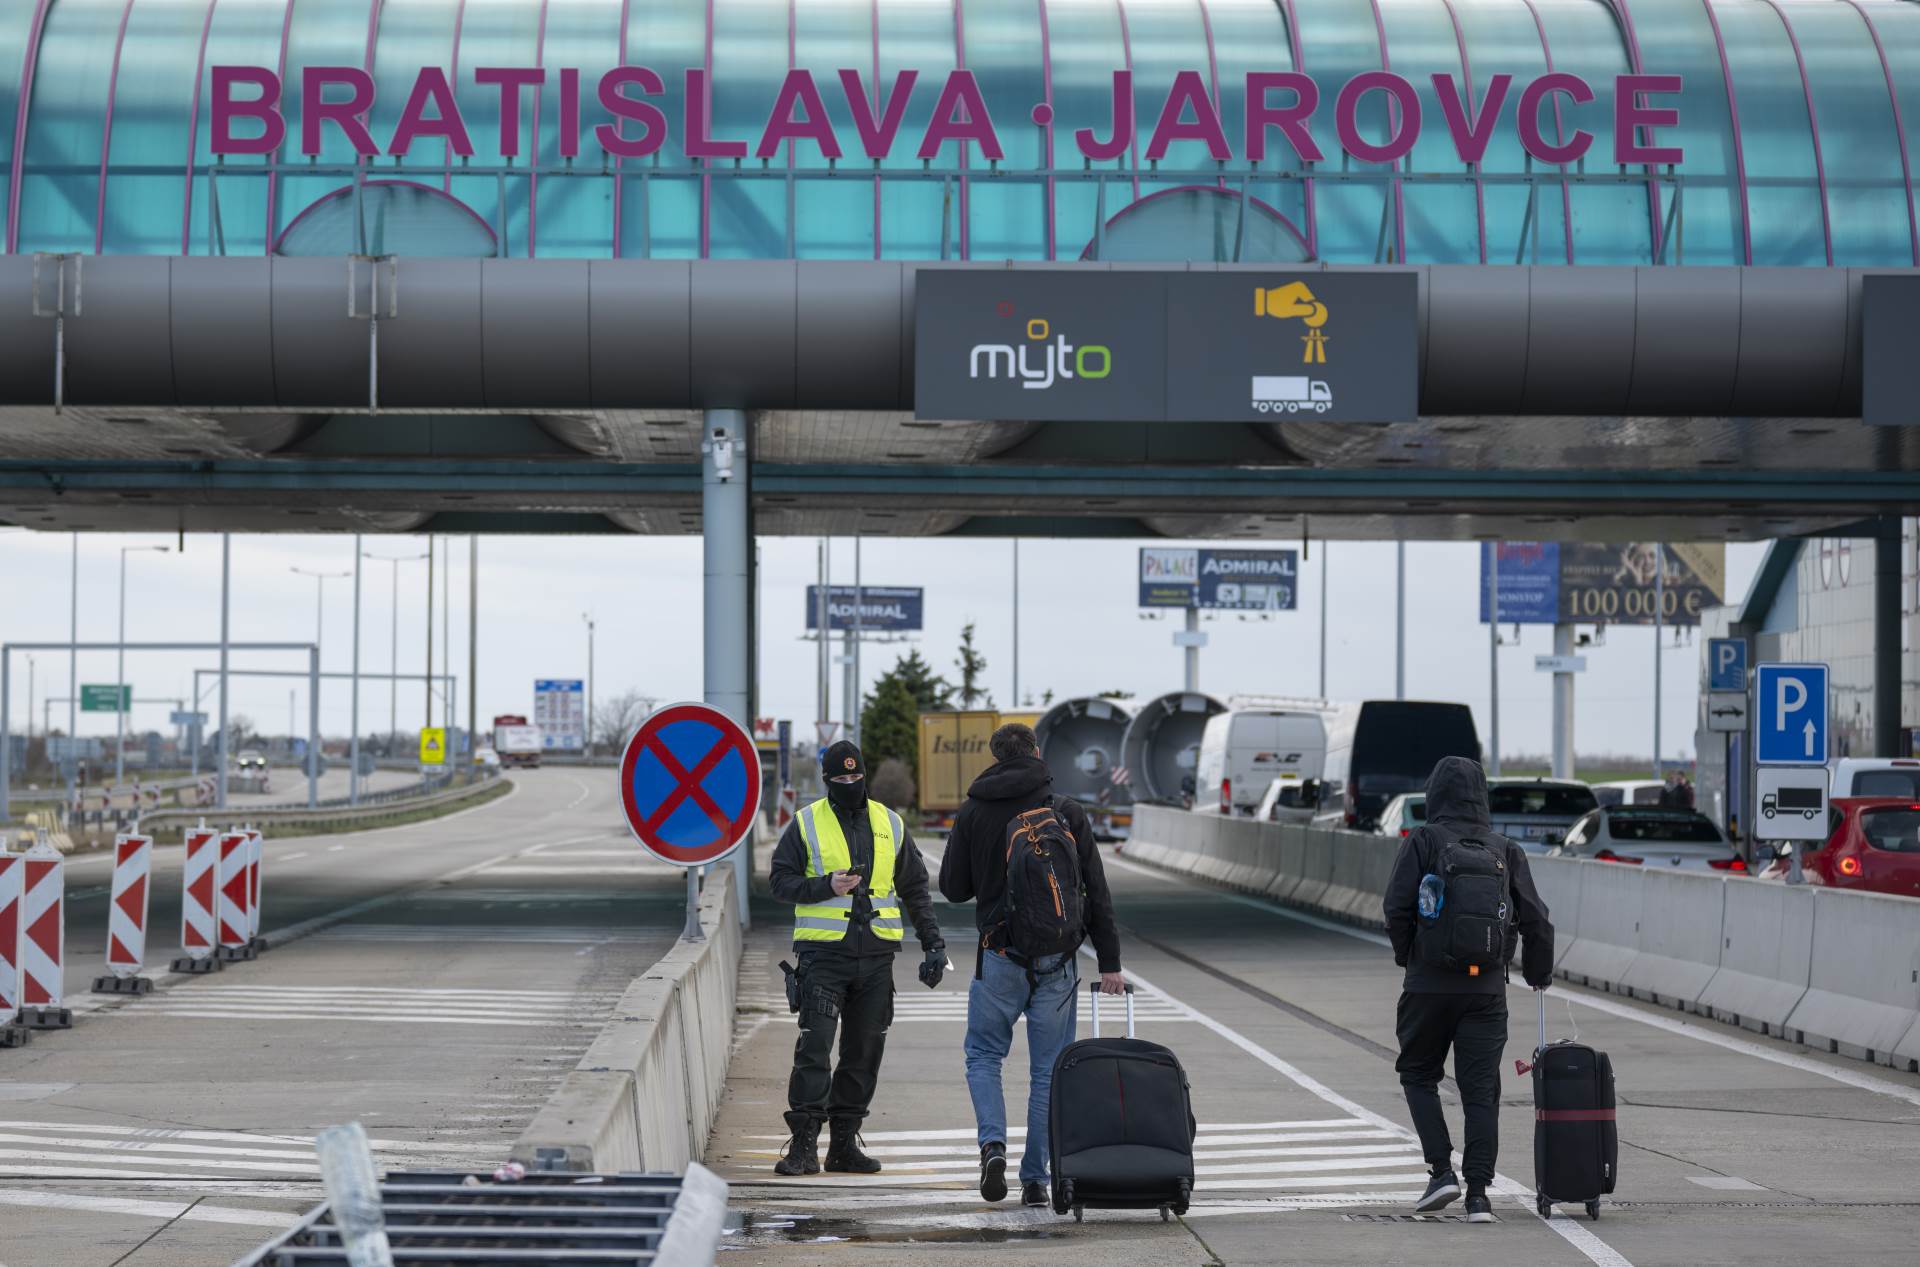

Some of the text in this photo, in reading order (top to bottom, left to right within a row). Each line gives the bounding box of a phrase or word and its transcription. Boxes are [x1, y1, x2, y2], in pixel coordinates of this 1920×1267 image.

[211, 66, 1683, 165] BRATISLAVA JAROVCE
[1203, 558, 1295, 576] ADMIRAL
[1569, 588, 1619, 616] 100
[1719, 644, 1736, 674] P
[1777, 677, 1807, 731] P
